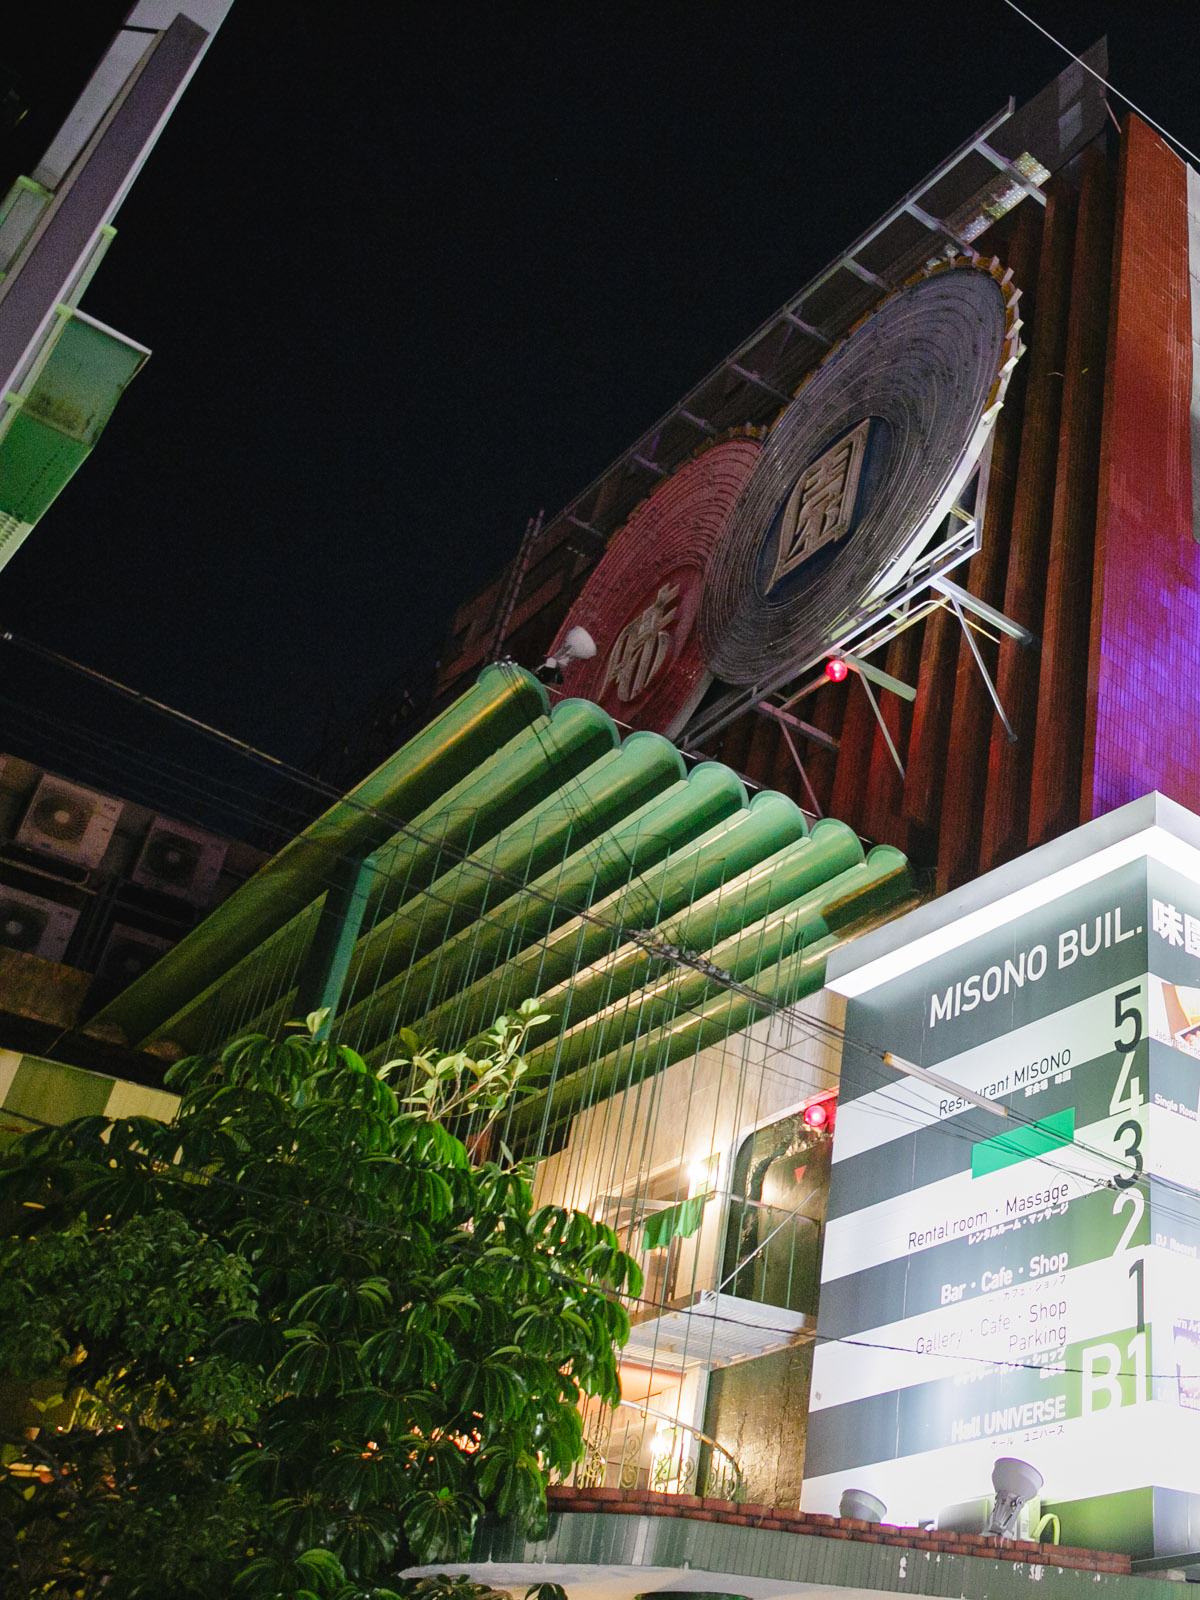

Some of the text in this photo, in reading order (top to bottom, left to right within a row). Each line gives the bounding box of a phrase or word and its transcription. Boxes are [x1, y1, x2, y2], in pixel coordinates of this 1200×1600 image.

[929, 906, 1143, 1028] MISONO BUIL.
[1114, 984, 1144, 1054] 5
[939, 1048, 1071, 1116] Resurant MISONO
[1109, 1050, 1144, 1116] 4
[1113, 1119, 1144, 1189] 3
[908, 1183, 1069, 1249] Rental room Massage
[1112, 1187, 1146, 1257] 2
[940, 1251, 1069, 1305] Bar Cafe Shop
[1128, 1258, 1145, 1334] 1
[980, 1314, 1011, 1337] Cafe
[1029, 1300, 1067, 1323] Shop
[1009, 1325, 1067, 1353] Parking
[1081, 1333, 1147, 1417] B1
[951, 1394, 1067, 1443] Hall UNIVERSE
